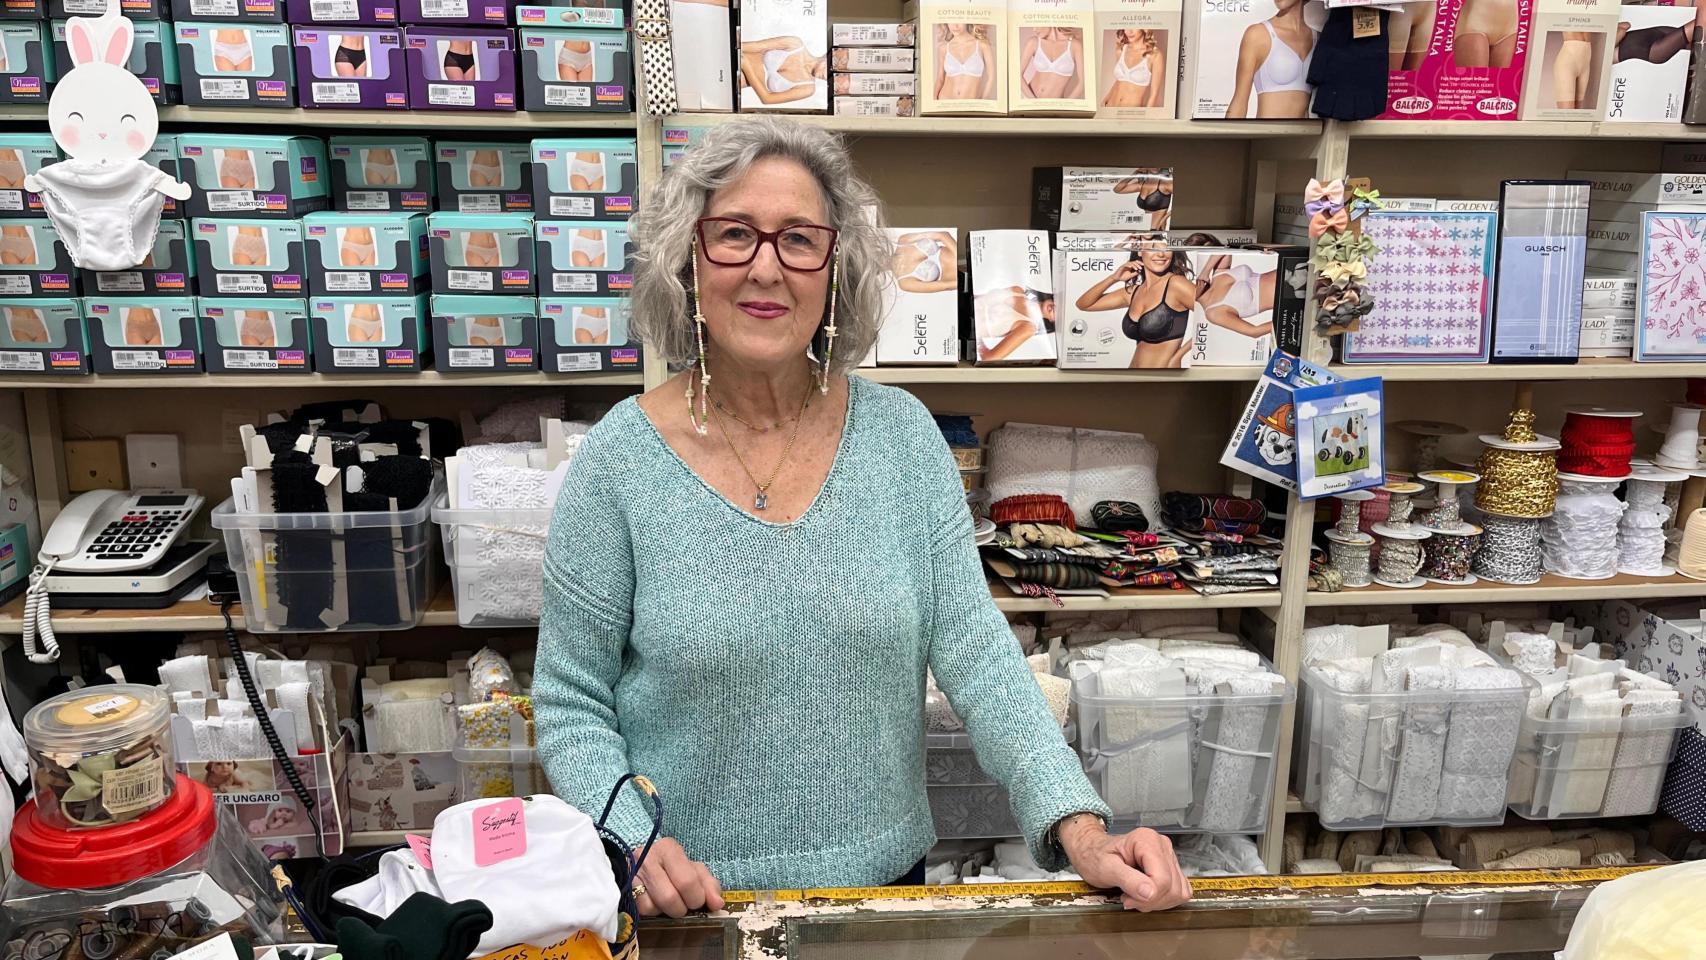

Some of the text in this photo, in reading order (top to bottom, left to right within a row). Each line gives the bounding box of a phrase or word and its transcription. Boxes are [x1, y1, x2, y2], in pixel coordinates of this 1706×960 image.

[1430, 19, 1447, 56] TALLA
[1515, 20, 1529, 55] TALLA
[1609, 77, 1627, 118] Selene
[1385, 200, 1403, 208] ADY
[1450, 202, 1489, 210] GOLDEN
[1027, 235, 1041, 275] Selene
[1071, 257, 1114, 271] Selene
[1593, 281, 1617, 289] LADY
[913, 314, 927, 355] Selene
[1584, 320, 1608, 328] LADY
[1193, 323, 1208, 361] Selene
[1234, 426, 1246, 441] 2016
[1243, 408, 1254, 424] Spin
[232, 793, 280, 802] UNGARO
